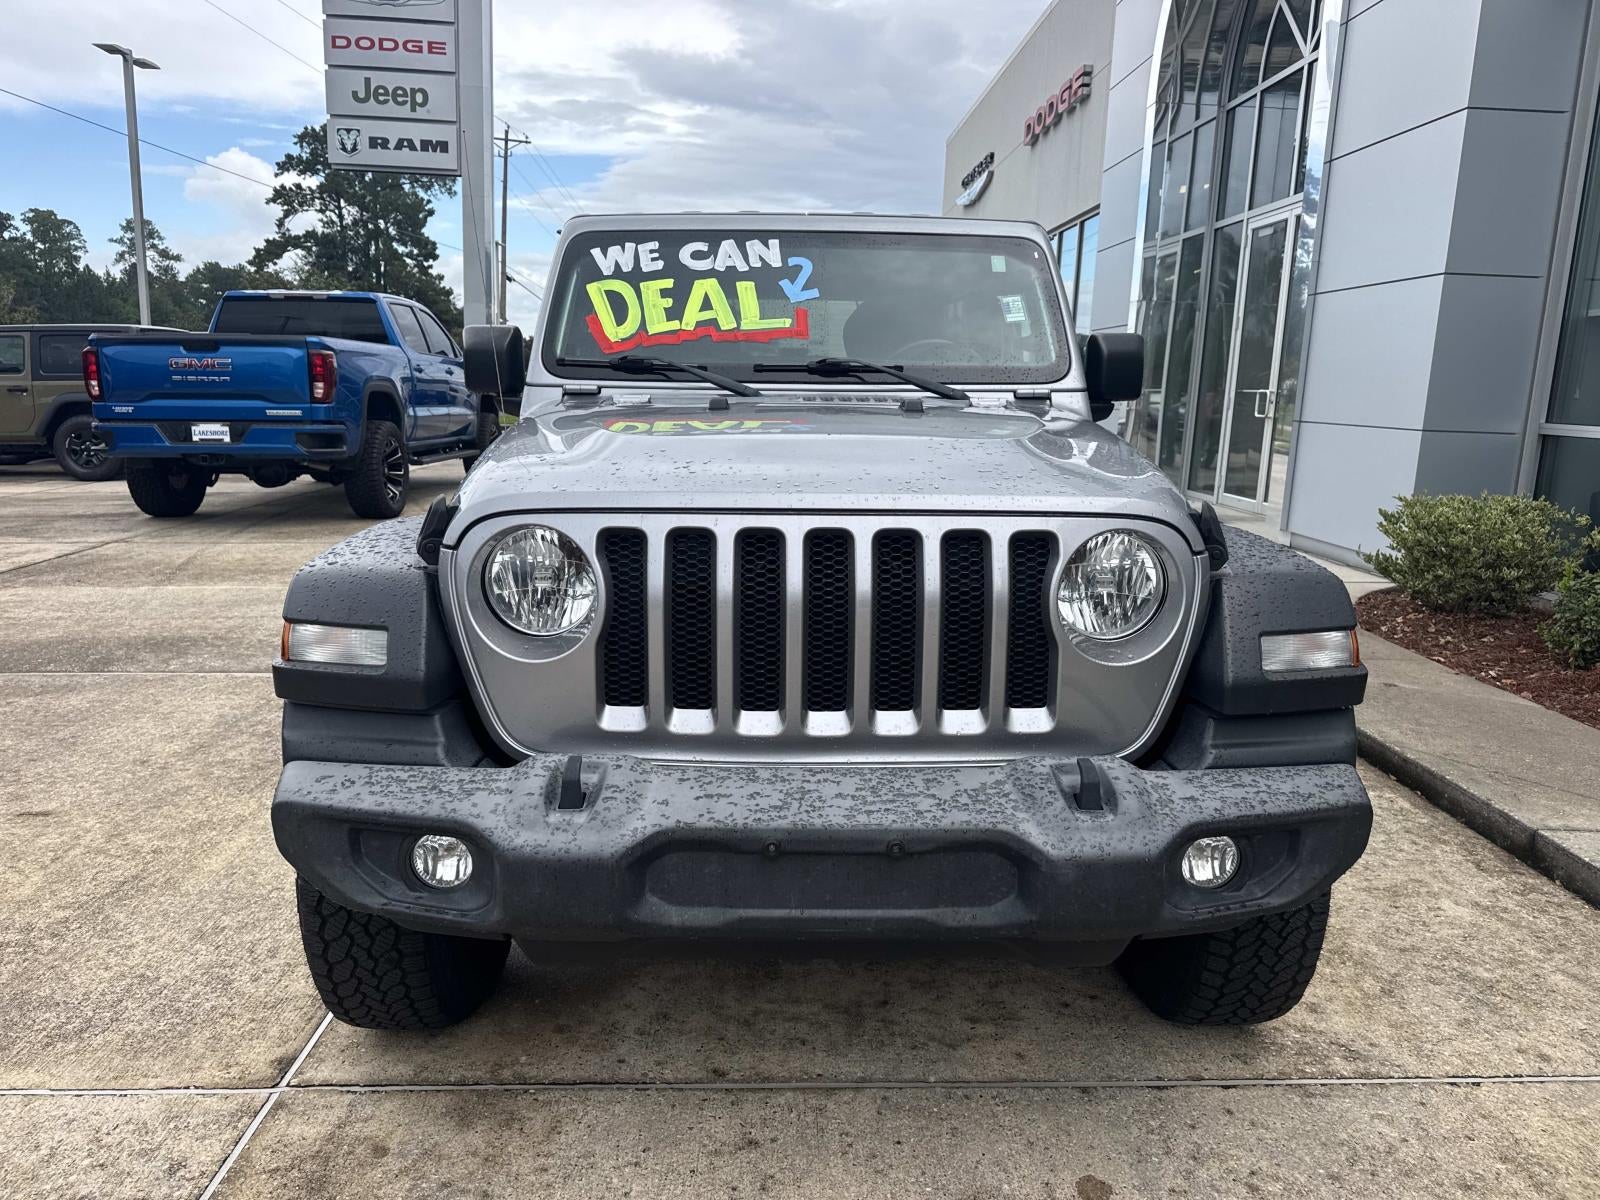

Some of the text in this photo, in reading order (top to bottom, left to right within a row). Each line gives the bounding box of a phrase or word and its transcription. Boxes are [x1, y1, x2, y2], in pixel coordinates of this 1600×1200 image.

[331, 35, 447, 55] DODGE
[351, 77, 430, 112] Jeep
[1023, 64, 1094, 146] DODGE
[368, 136, 449, 153] RAM
[590, 239, 783, 276] WE CAN
[586, 256, 820, 342] DEAL 2
[169, 358, 232, 371] GMC
[193, 428, 229, 437] LAKESHORE
